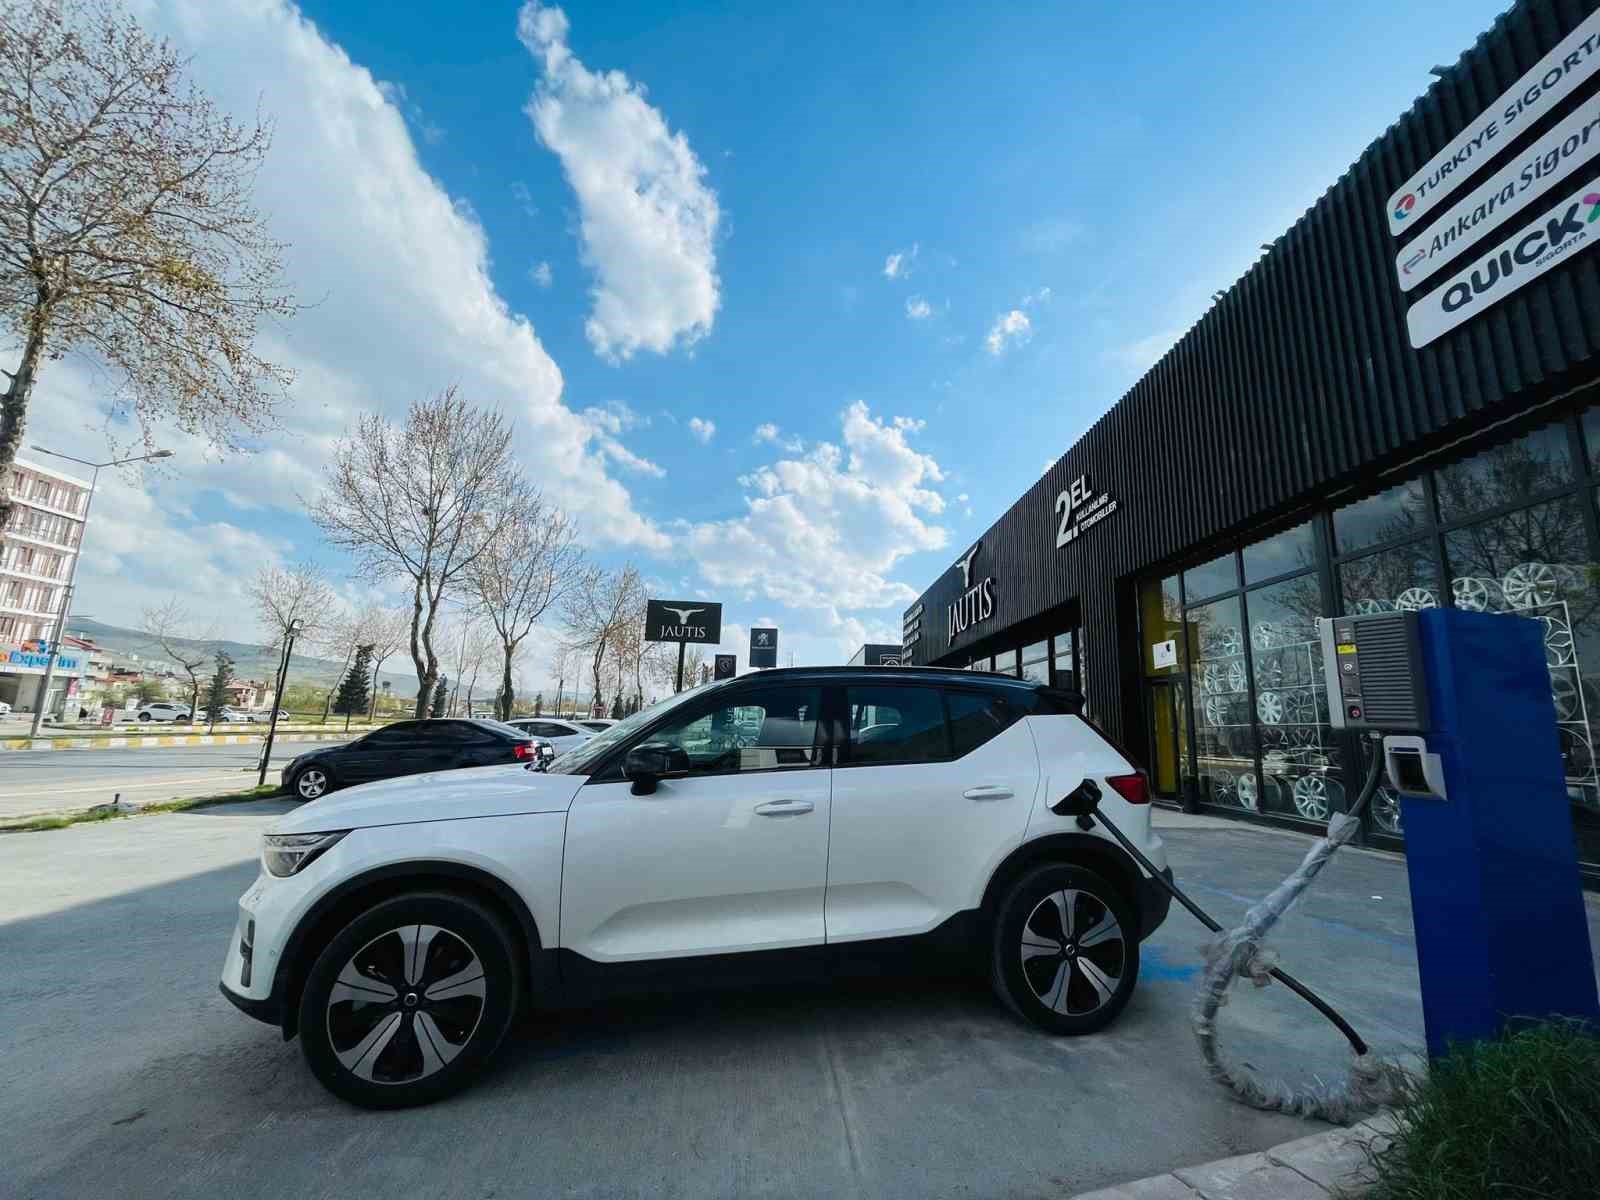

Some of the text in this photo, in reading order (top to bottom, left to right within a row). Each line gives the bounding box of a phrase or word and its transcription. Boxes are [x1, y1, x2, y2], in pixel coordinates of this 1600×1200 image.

[1503, 33, 1600, 126] SIGORT
[1429, 111, 1600, 259] Ankara Sigor
[1441, 202, 1585, 313] QUICK
[1071, 474, 1092, 510] EL
[660, 624, 706, 639] JAUTIS
[947, 577, 992, 648] JAUTIS
